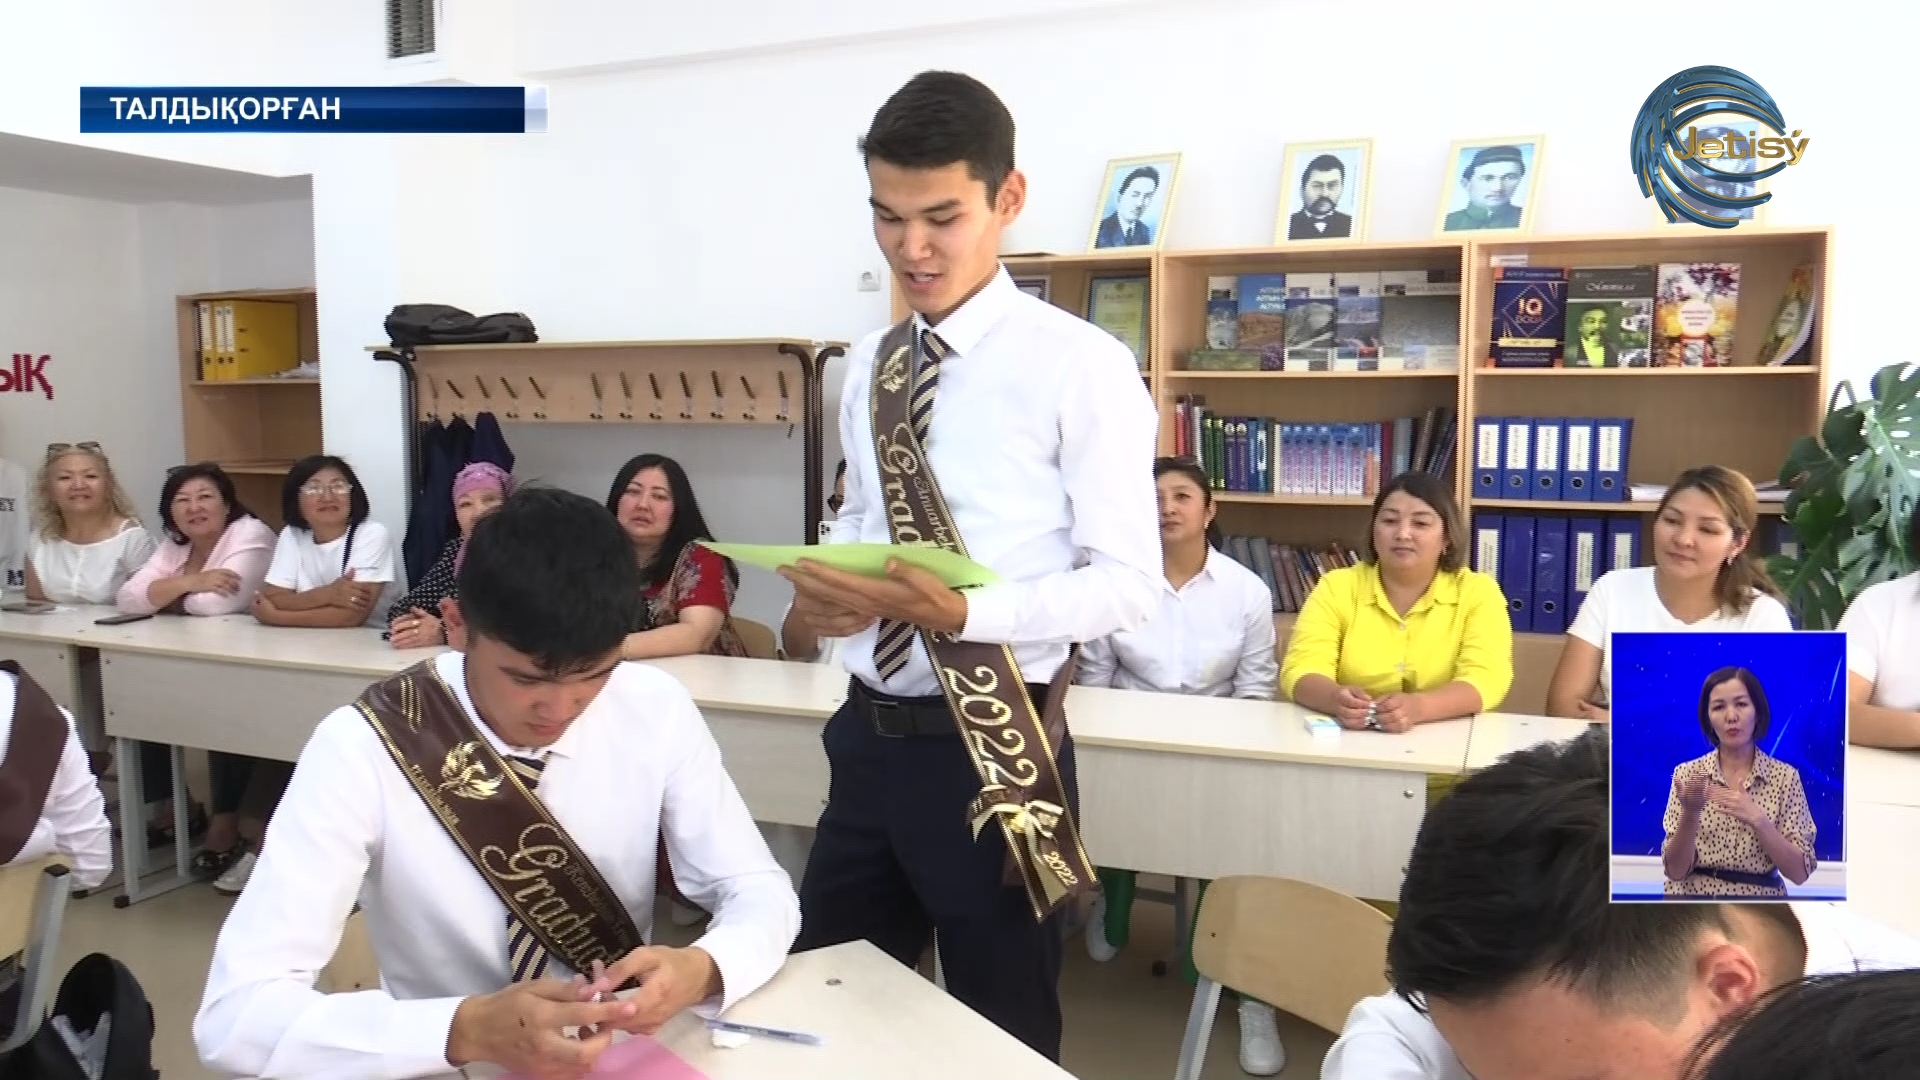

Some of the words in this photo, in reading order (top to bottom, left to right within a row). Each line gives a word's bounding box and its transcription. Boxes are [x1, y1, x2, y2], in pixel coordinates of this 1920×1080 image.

[943, 665, 1039, 787] 2022
[480, 822, 624, 972] Gradua
[1042, 851, 1078, 886] 2022
